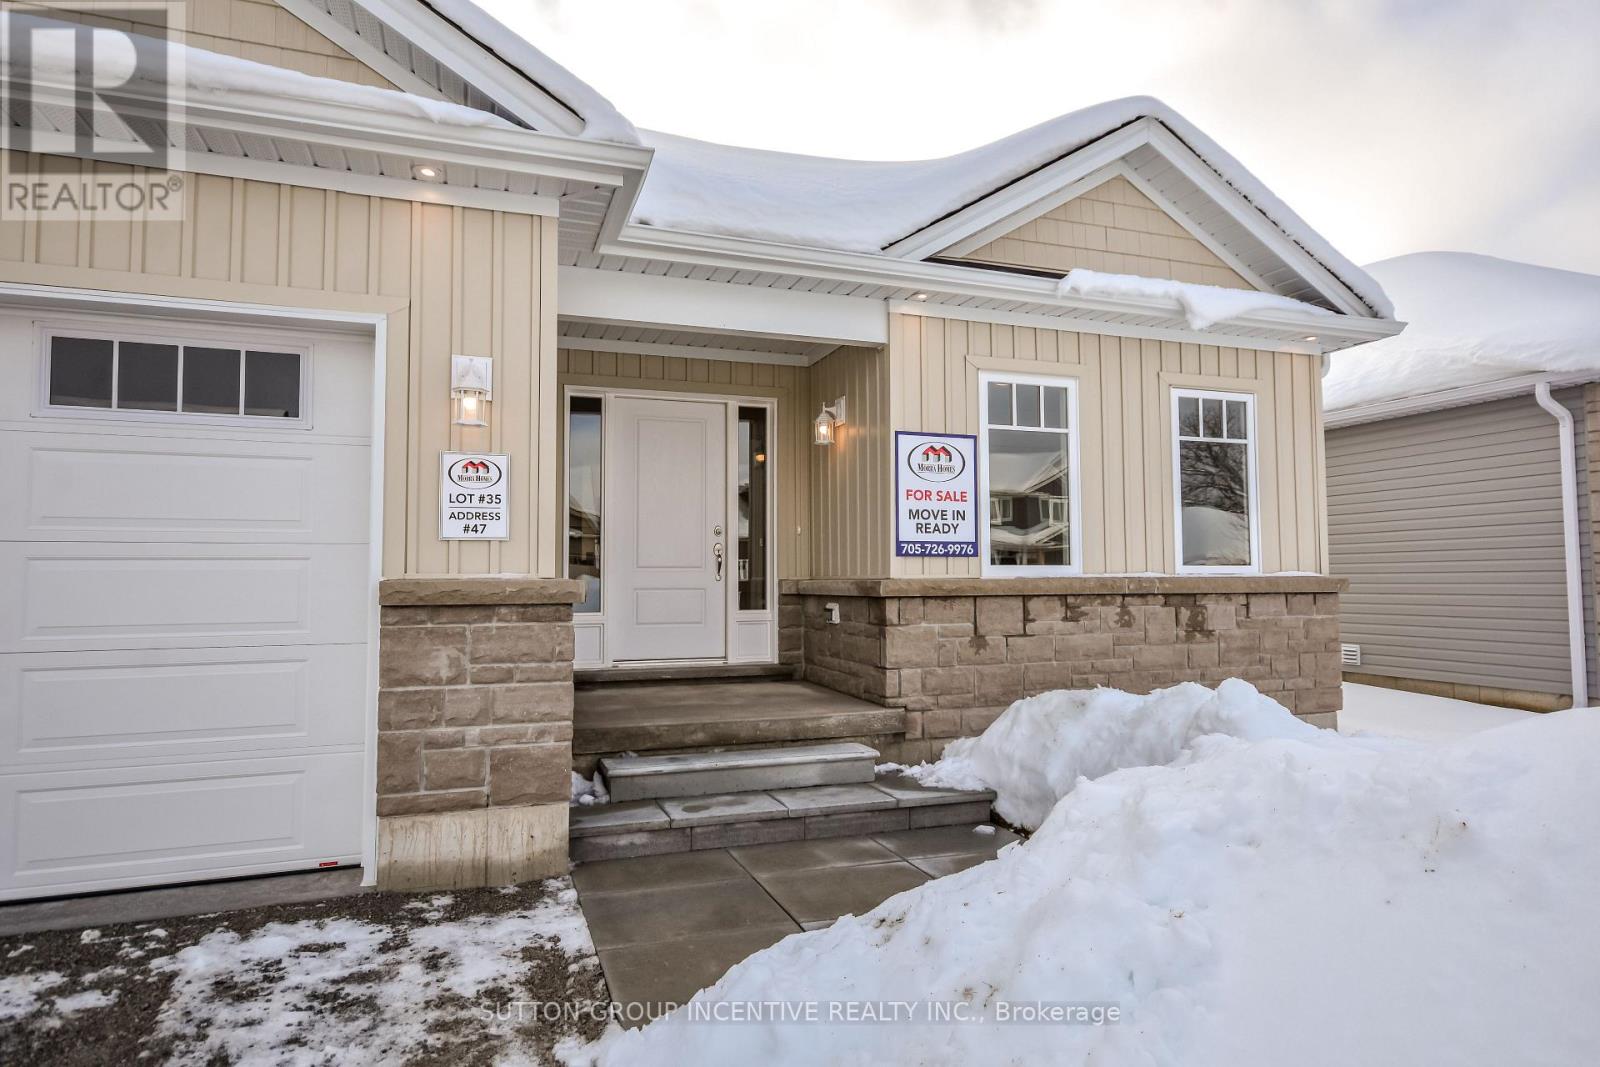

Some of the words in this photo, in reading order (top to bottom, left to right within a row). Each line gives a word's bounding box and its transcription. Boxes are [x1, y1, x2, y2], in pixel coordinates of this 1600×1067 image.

[449, 493, 475, 503] LOT
[478, 494, 502, 504] #35
[906, 489, 932, 501] FOR
[936, 491, 967, 502] SALE
[449, 511, 501, 520] ADDRESS
[908, 509, 948, 521] MOVE
[952, 510, 966, 521] IN
[463, 523, 487, 534] #47
[915, 523, 959, 534] READY
[900, 543, 974, 555] 705-726-9976
